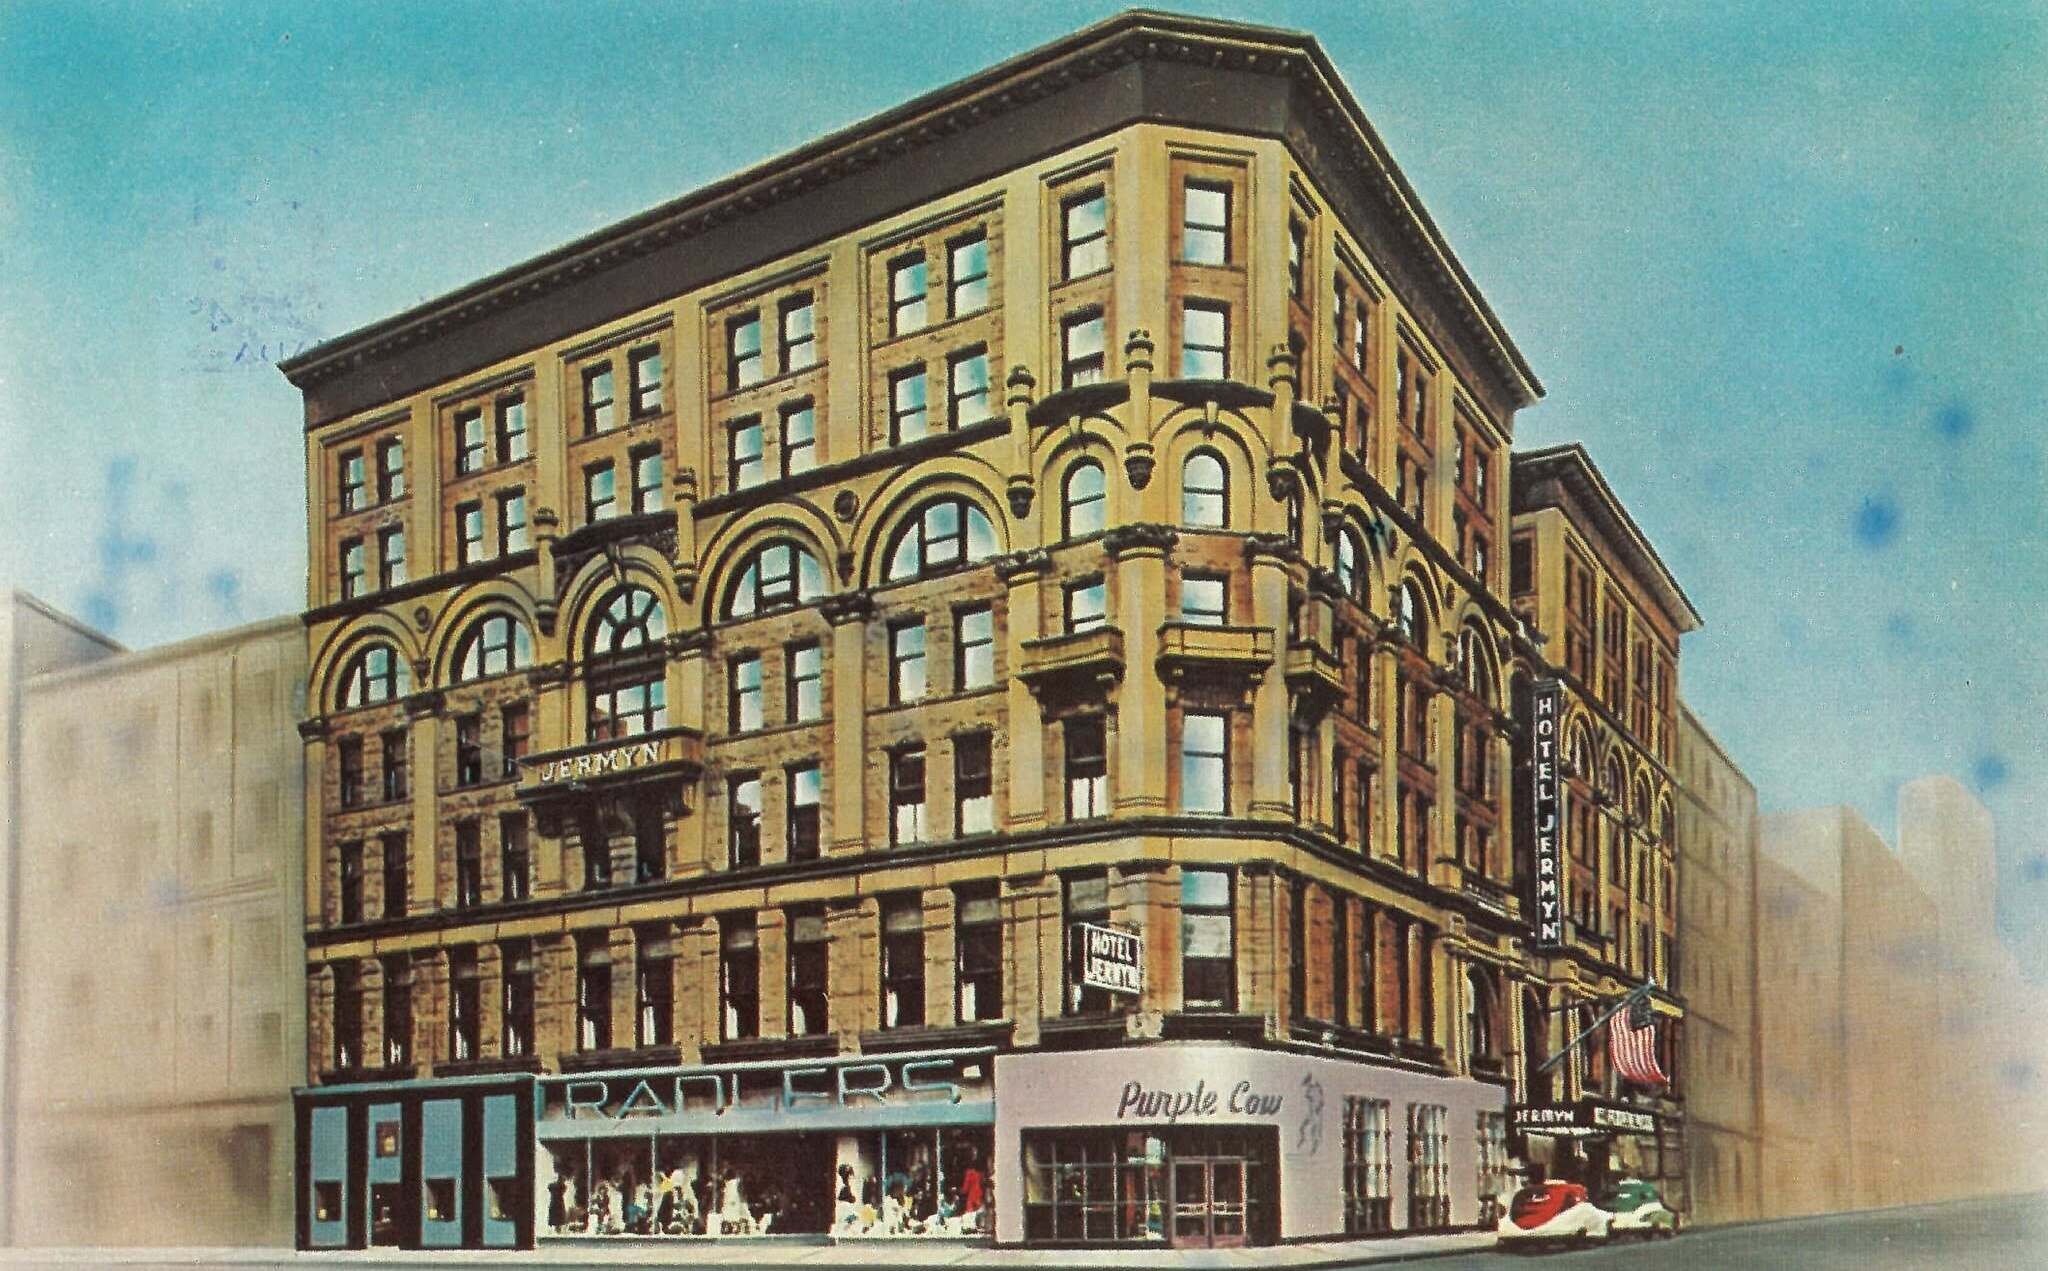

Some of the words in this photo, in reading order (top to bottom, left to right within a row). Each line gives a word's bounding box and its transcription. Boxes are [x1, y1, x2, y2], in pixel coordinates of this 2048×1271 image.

[541, 741, 663, 781] JERMYN
[1539, 697, 1553, 800] HOTEL
[1540, 814, 1559, 940] JERMYN
[1091, 930, 1132, 962] HOTEL
[1117, 1079, 1218, 1122] Purple
[1229, 1079, 1283, 1115] Cow
[1514, 1108, 1574, 1124] JERMYN
